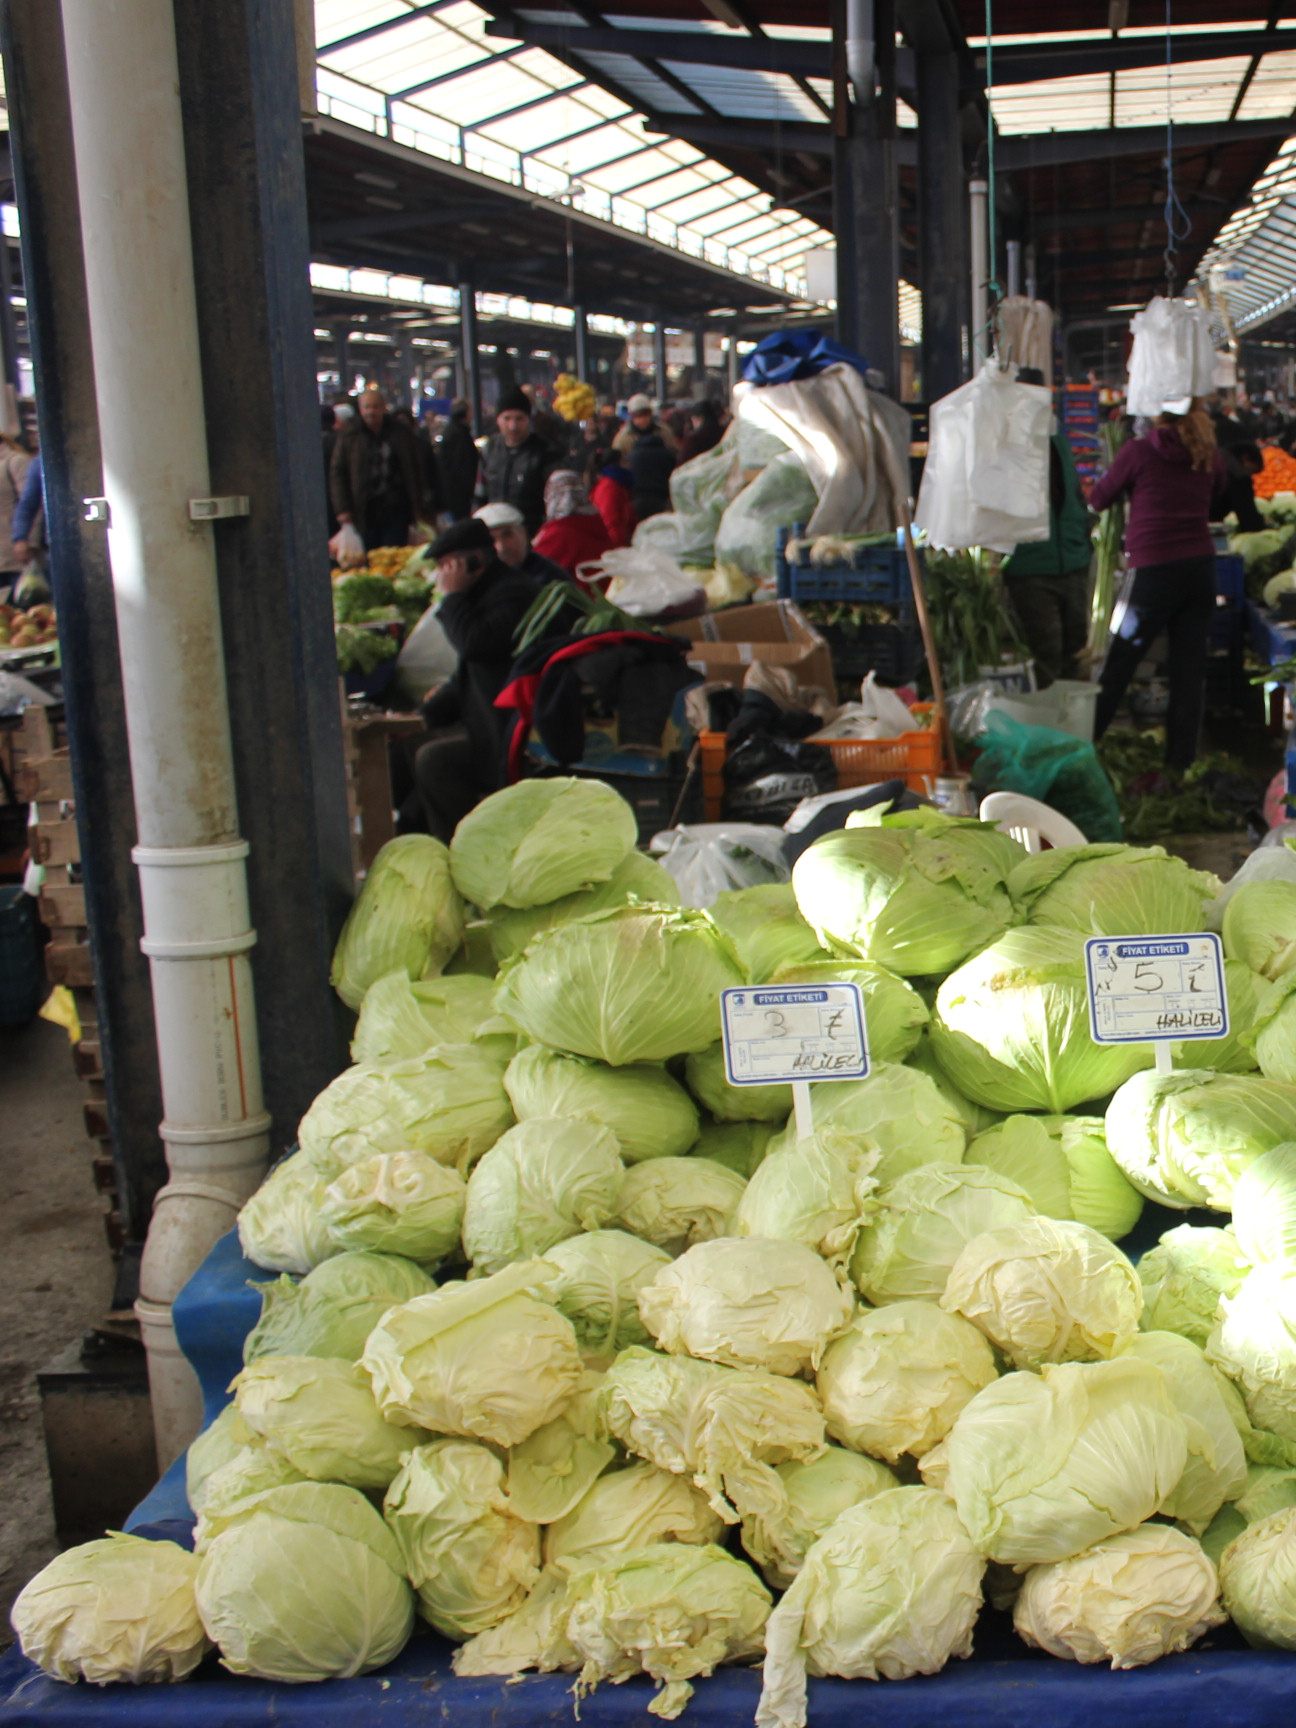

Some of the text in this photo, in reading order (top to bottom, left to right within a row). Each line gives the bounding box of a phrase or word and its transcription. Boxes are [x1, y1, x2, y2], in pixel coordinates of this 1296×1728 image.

[1122, 943, 1184, 956] FİYAT ETİKETİ
[1133, 961, 1164, 994] 5
[758, 992, 823, 1004] FİYAT ETİKETİ
[763, 1010, 788, 1039] 3
